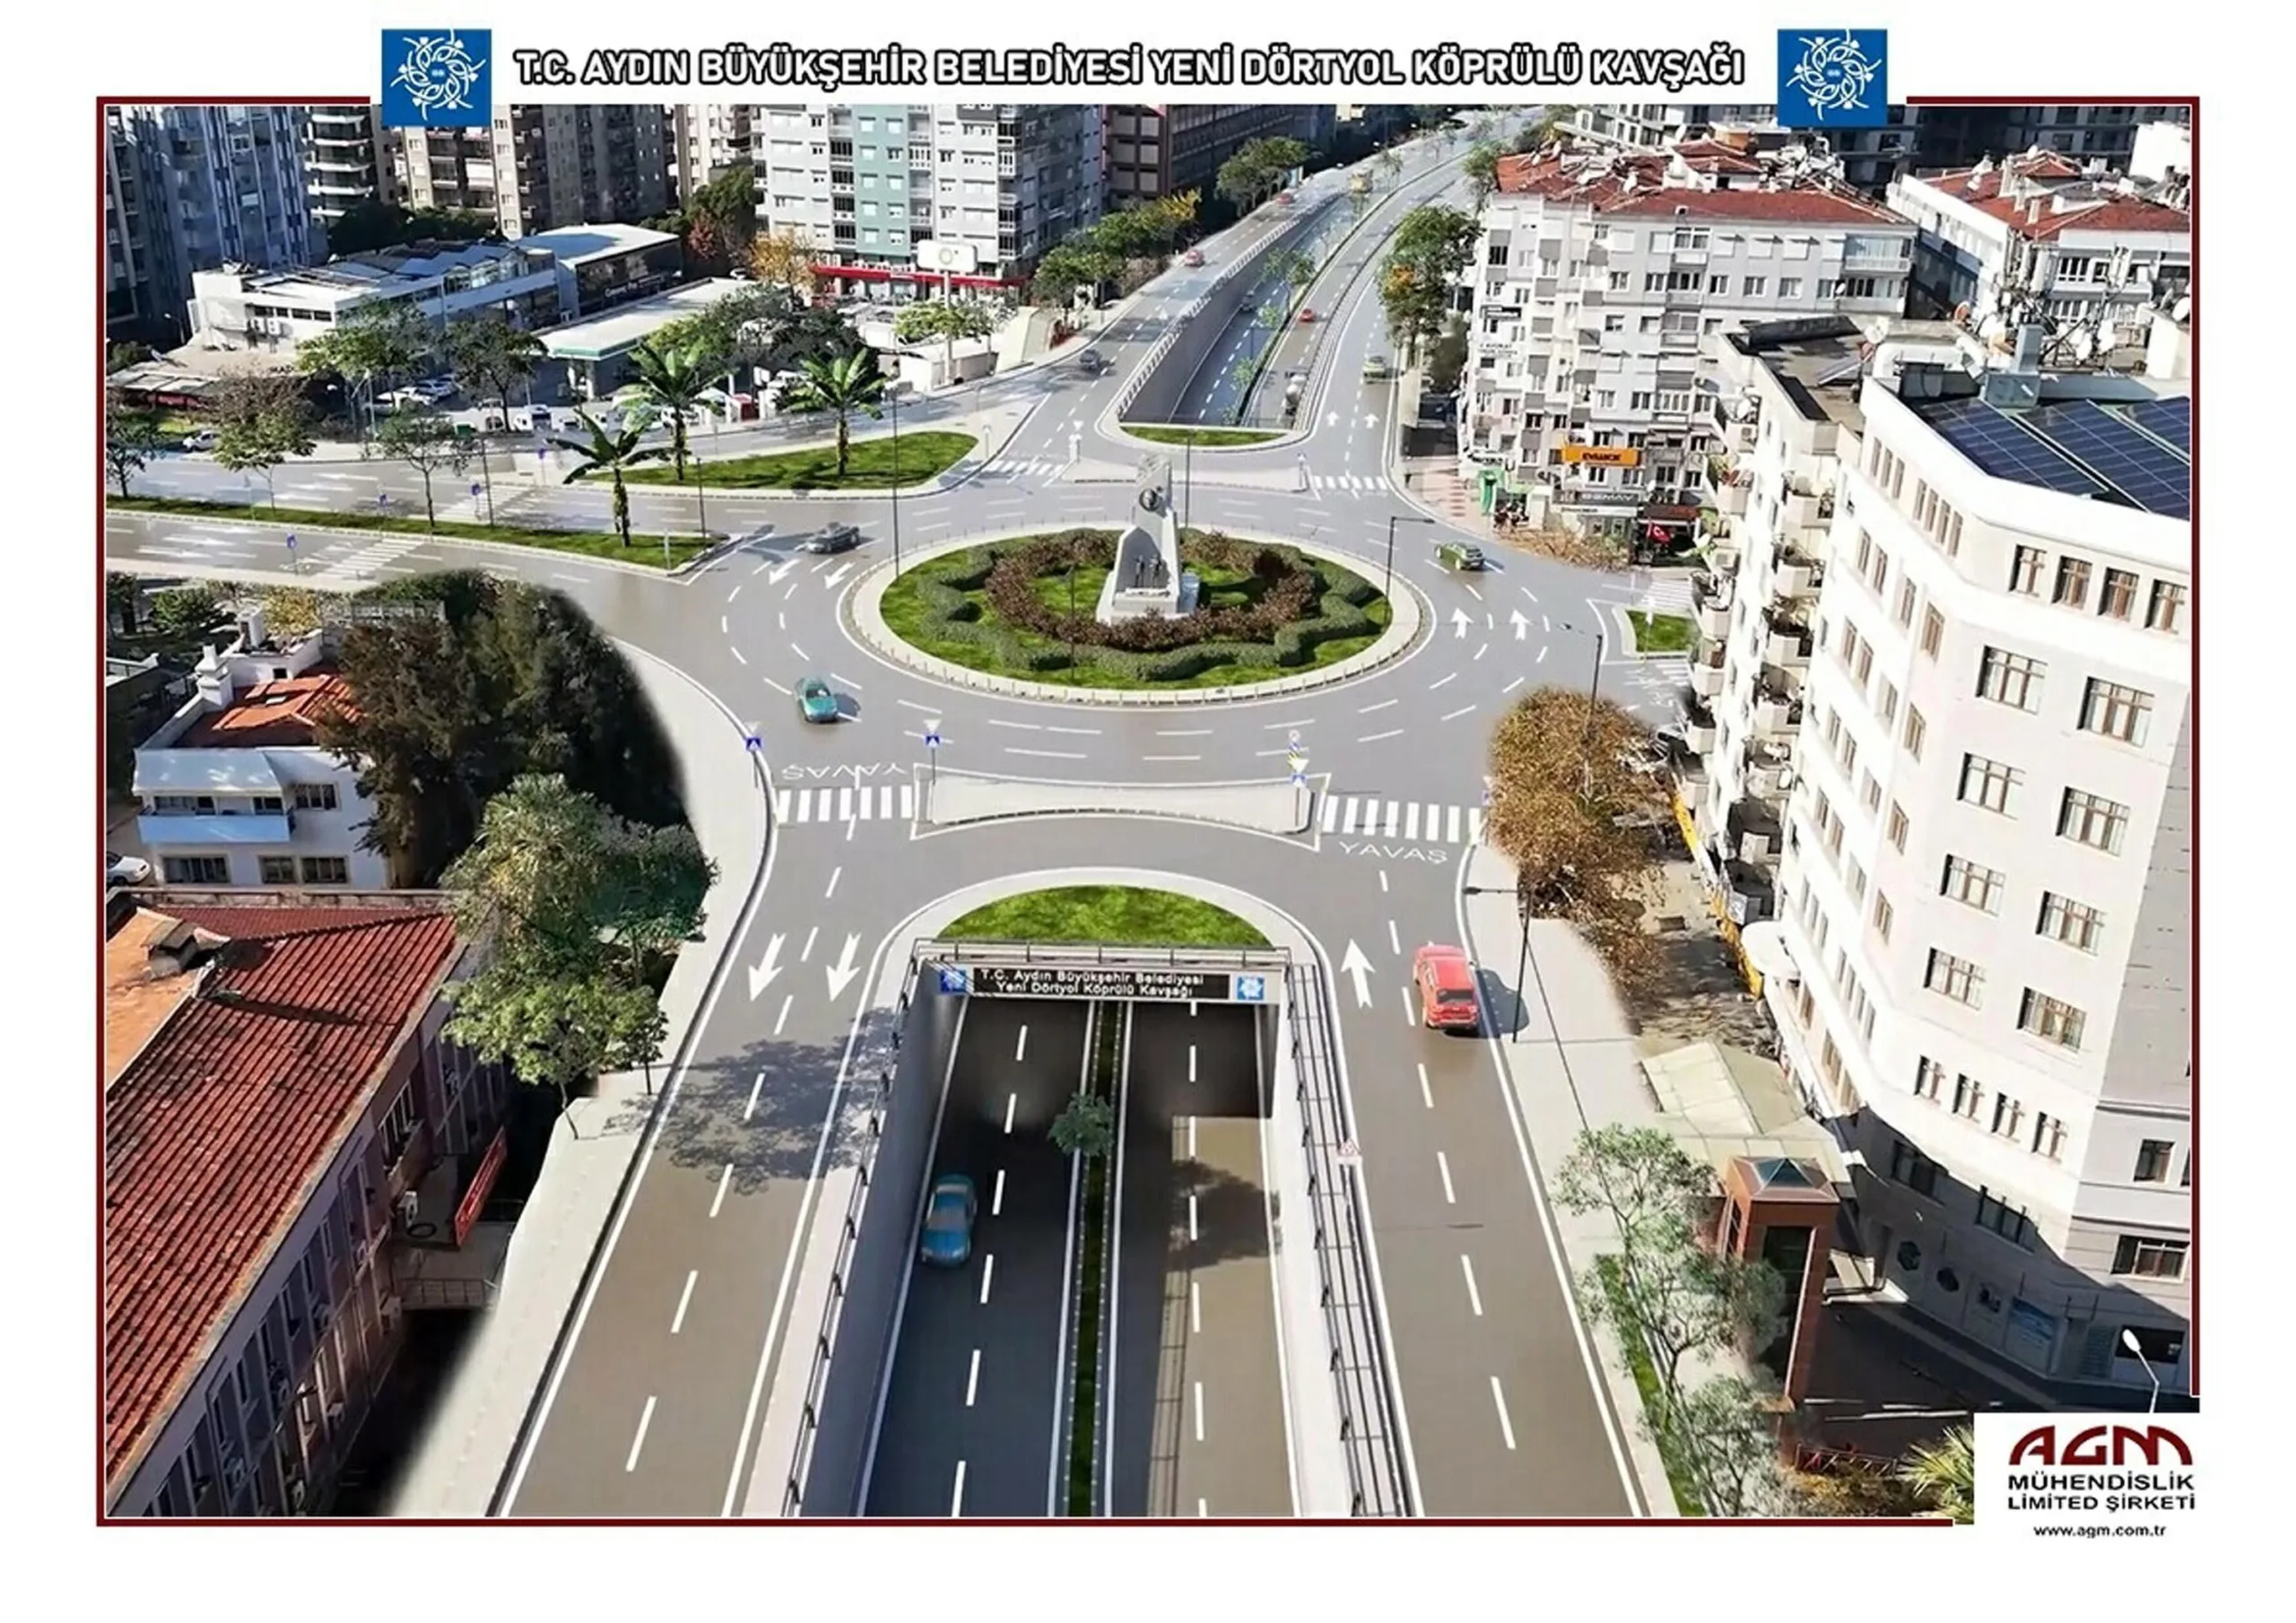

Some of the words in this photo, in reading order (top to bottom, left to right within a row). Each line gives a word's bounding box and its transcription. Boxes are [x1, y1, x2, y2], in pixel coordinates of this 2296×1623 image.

[981, 968, 1009, 980] T.C.
[1014, 969, 1052, 983] Aydın
[1135, 972, 1204, 986] Belediyesi
[996, 981, 1027, 992] Yeni
